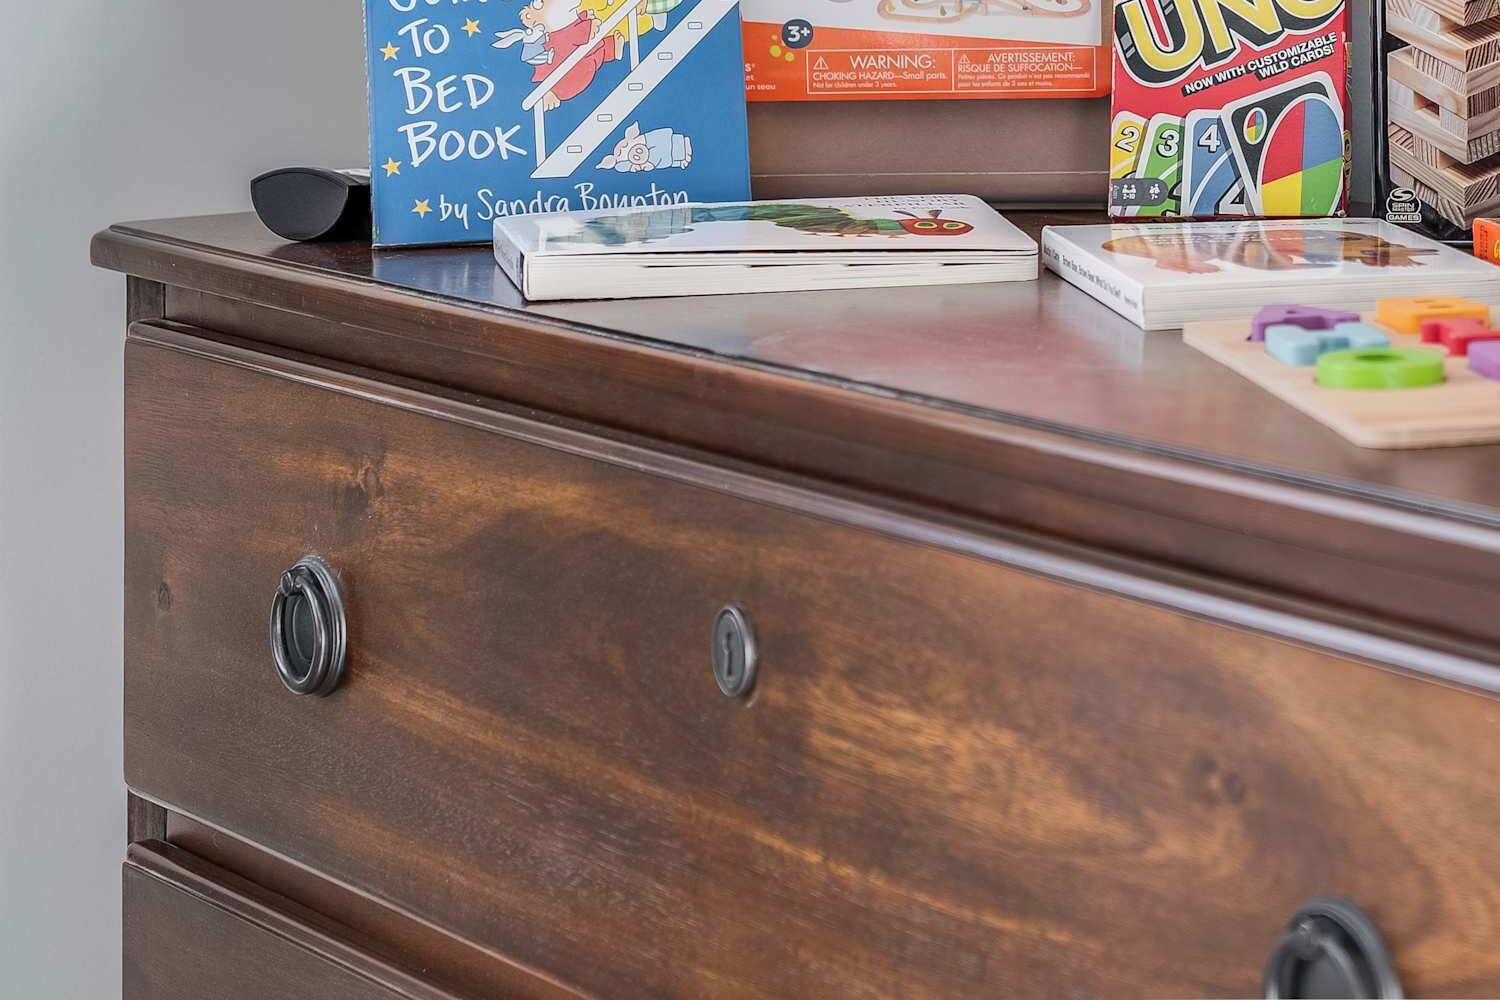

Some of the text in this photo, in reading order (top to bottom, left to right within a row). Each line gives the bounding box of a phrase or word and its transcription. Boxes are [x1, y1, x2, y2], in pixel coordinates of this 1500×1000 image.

[397, 17, 450, 59] TO
[787, 25, 811, 42] 3+
[849, 54, 936, 69] WARNING:
[958, 63, 992, 73] RISQUE
[993, 63, 1006, 72] DE
[987, 52, 1076, 63] AVERTISSEMENT:
[1185, 32, 1337, 93] NOW WITH CUSTOMIZABLE
[1259, 45, 1334, 78] WILD CARDS!
[813, 71, 857, 81] CHOKING
[393, 66, 495, 117] BED
[397, 119, 528, 169] BOOK
[1115, 126, 1140, 152] 2
[1157, 129, 1180, 157] 3
[1198, 124, 1221, 153] 4
[439, 189, 469, 230] by
[477, 187, 569, 221] Sandra
